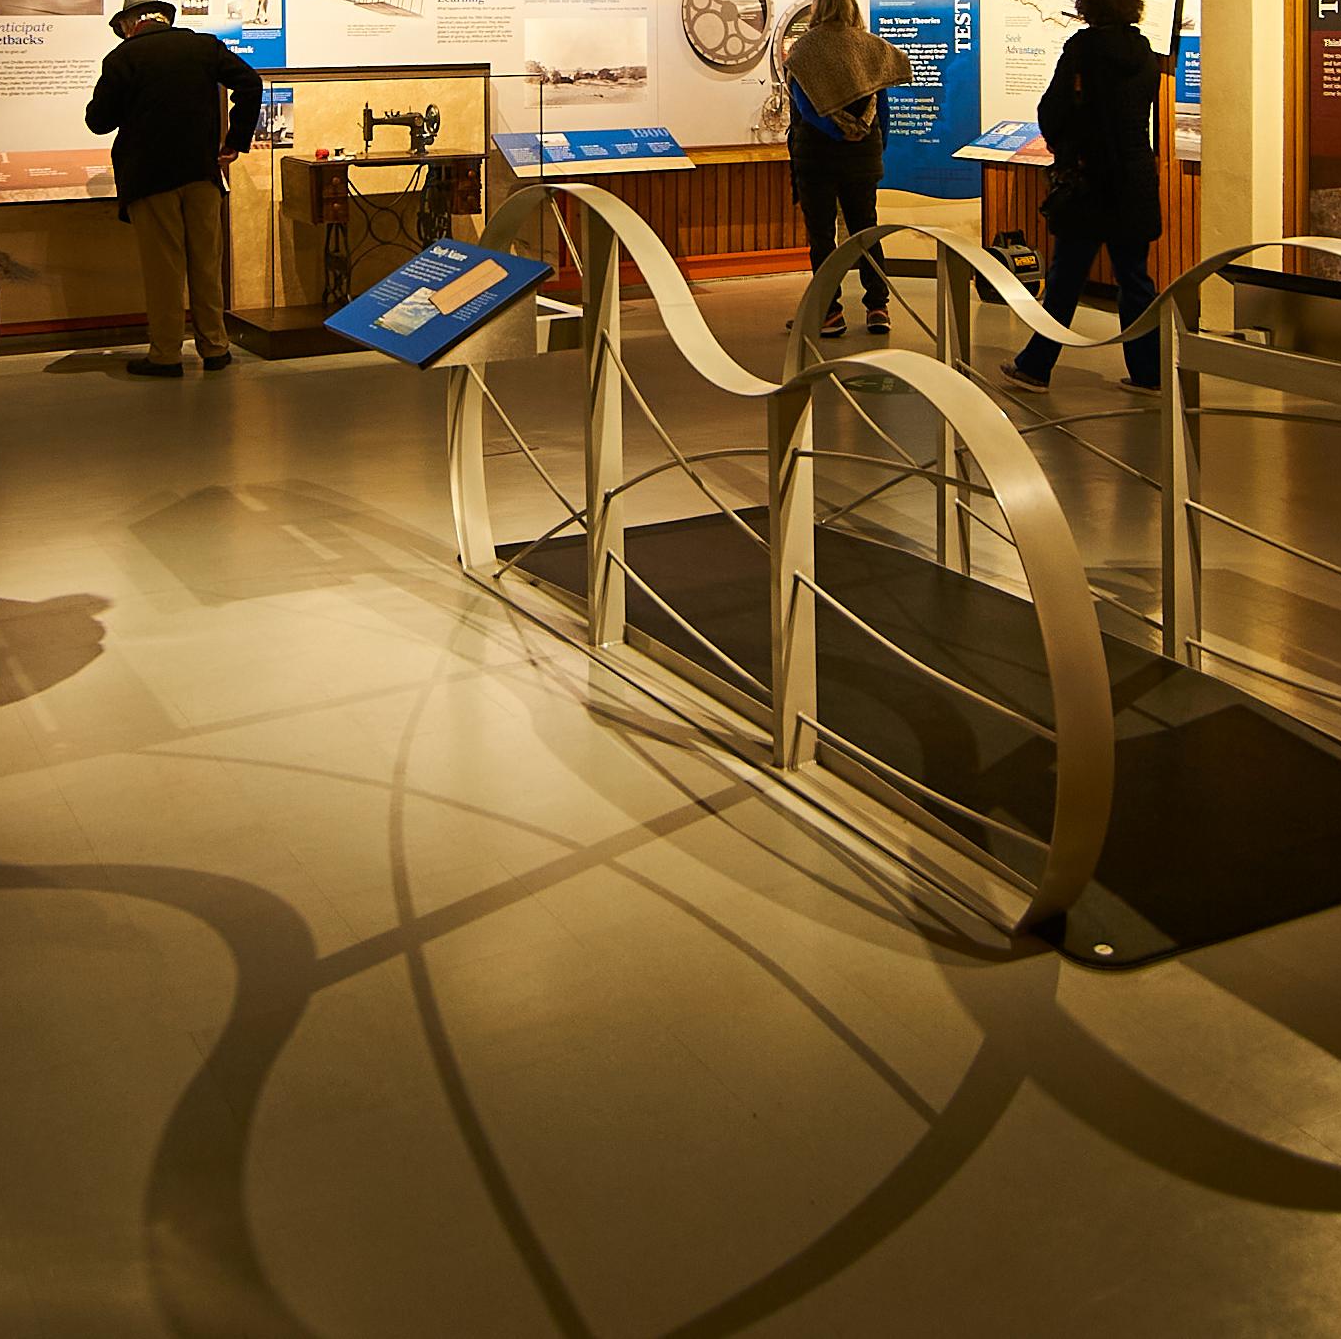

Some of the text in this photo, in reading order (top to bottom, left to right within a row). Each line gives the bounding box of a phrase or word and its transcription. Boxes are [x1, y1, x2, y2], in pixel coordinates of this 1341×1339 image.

[955, 0, 971, 54] TEST
[1005, 34, 1022, 43] Seek
[1005, 46, 1046, 57] Advantages
